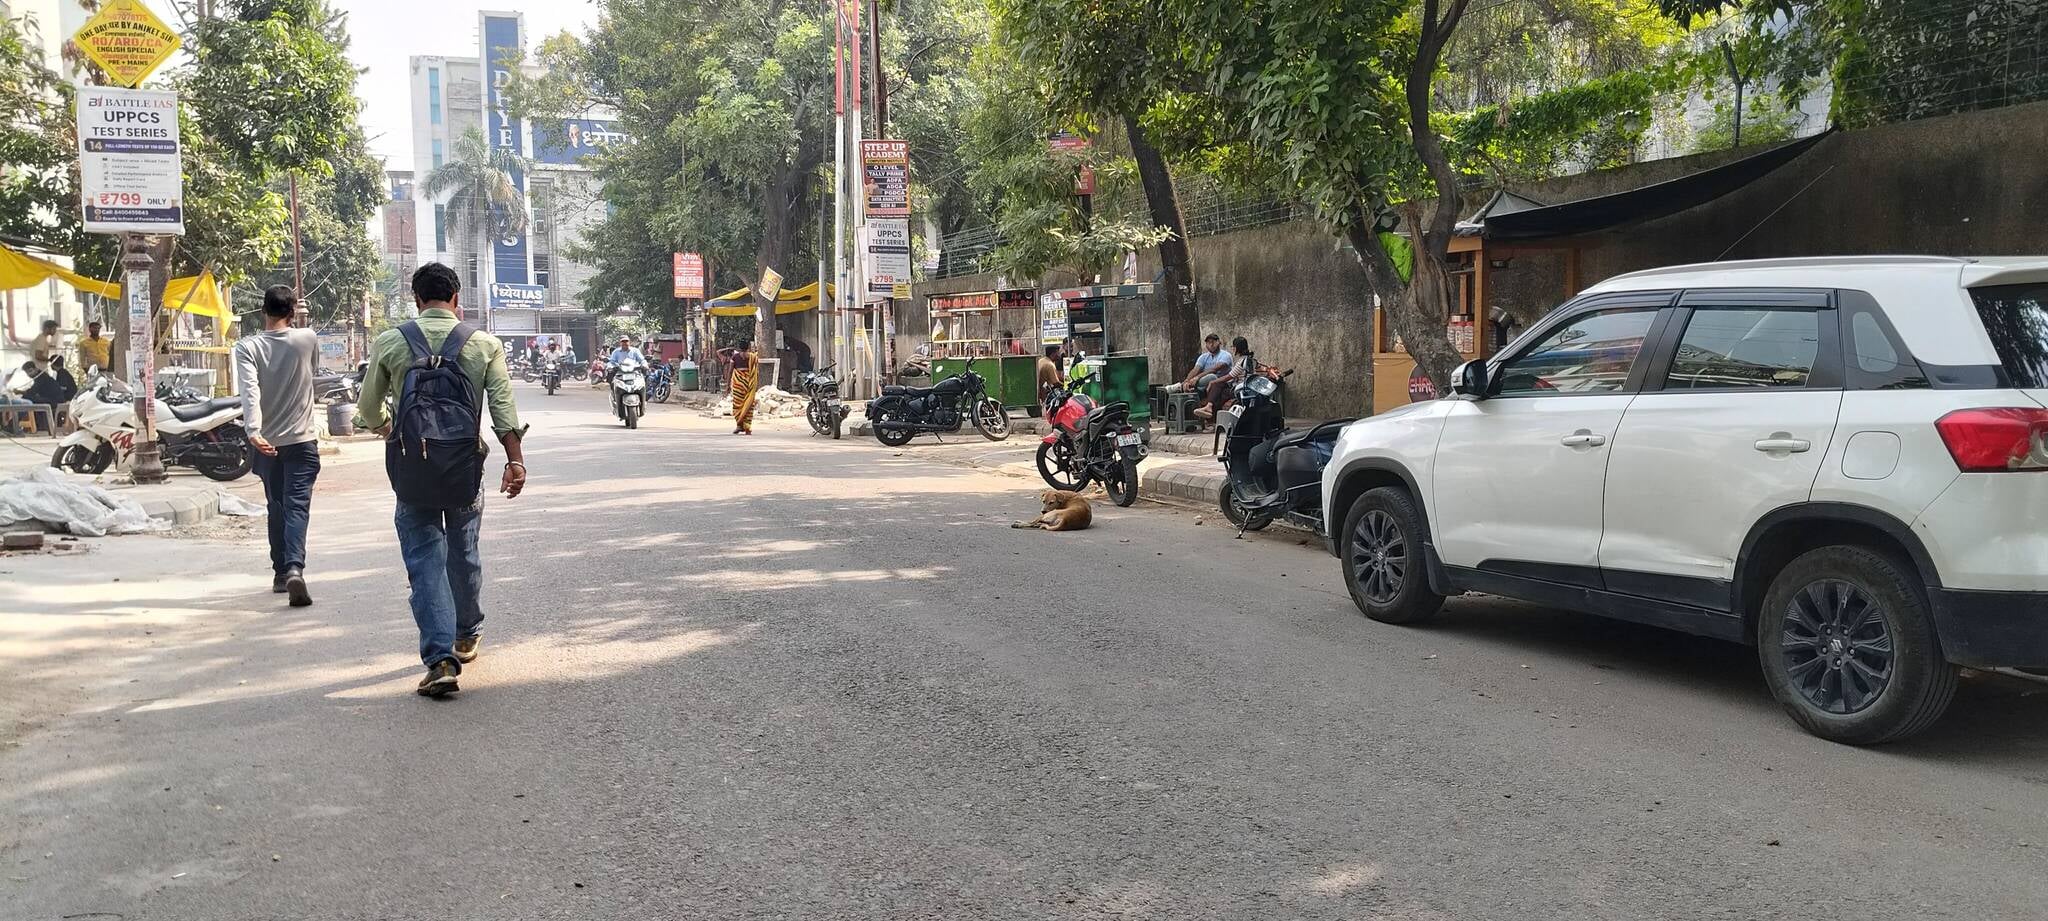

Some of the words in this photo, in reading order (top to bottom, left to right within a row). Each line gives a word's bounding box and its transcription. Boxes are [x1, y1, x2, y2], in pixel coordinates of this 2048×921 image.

[80, 32, 94, 40] ONE
[133, 23, 160, 36] ANIKET
[105, 99, 151, 108] BATTLE
[154, 100, 173, 108] IAS
[104, 111, 160, 124] UPPCS
[92, 127, 122, 136] TEST
[126, 128, 168, 138] SERIES
[90, 141, 102, 150] 14
[100, 192, 141, 205] ₹799
